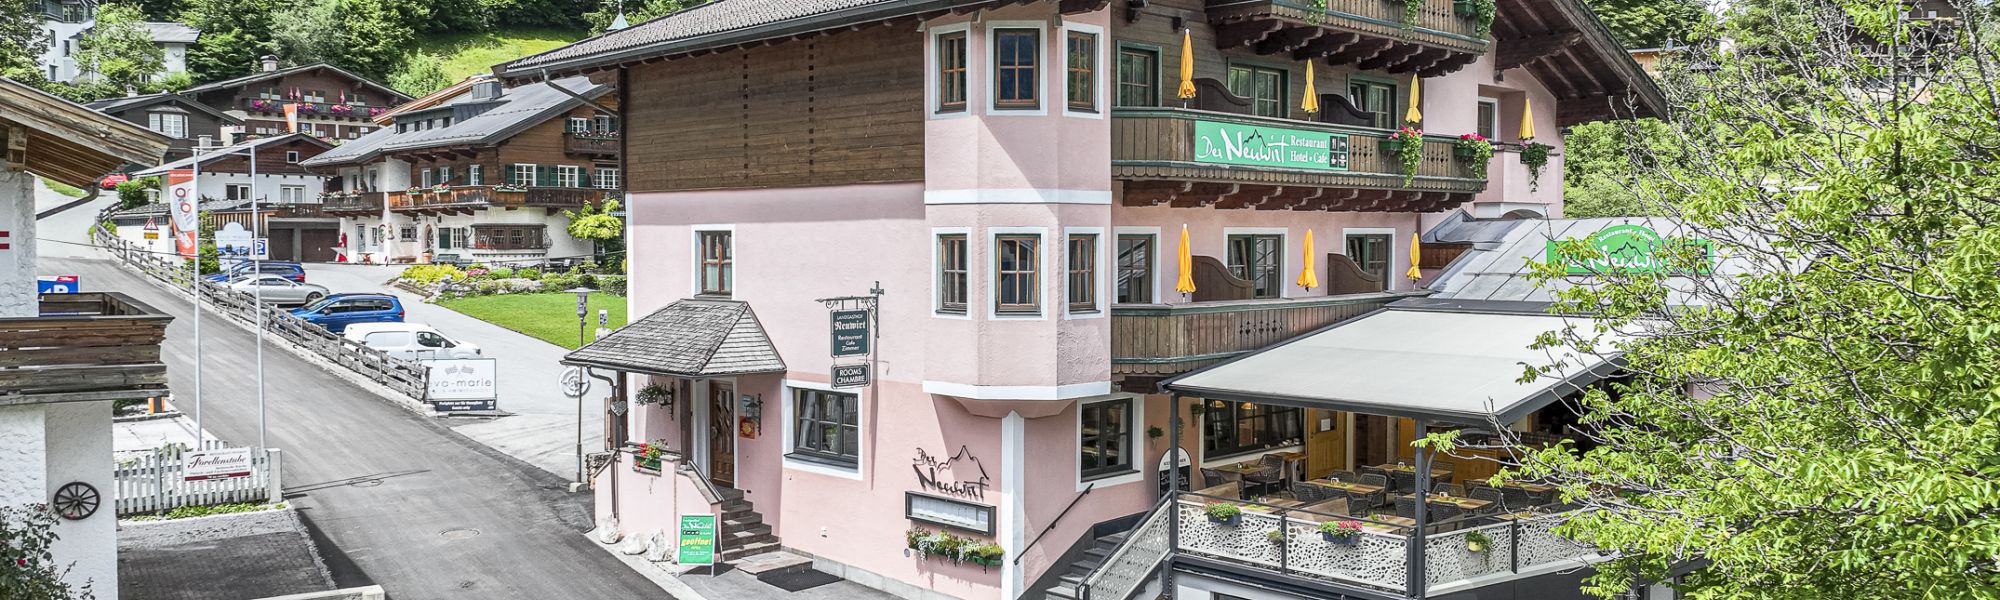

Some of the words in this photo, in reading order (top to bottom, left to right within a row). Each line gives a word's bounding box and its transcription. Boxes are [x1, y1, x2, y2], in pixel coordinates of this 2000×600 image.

[1197, 136, 1222, 159] Der
[1220, 128, 1290, 163] Neuwirt
[1290, 135, 1327, 149] Restaurant
[1290, 150, 1308, 163] Hotel
[834, 320, 866, 330] Neuwirt
[839, 368, 862, 376] ROOMS
[836, 375, 865, 384] CHAMBRE
[187, 453, 247, 468] Forellenstube
[913, 447, 937, 465] Der
[912, 464, 989, 499] Neuwirt
